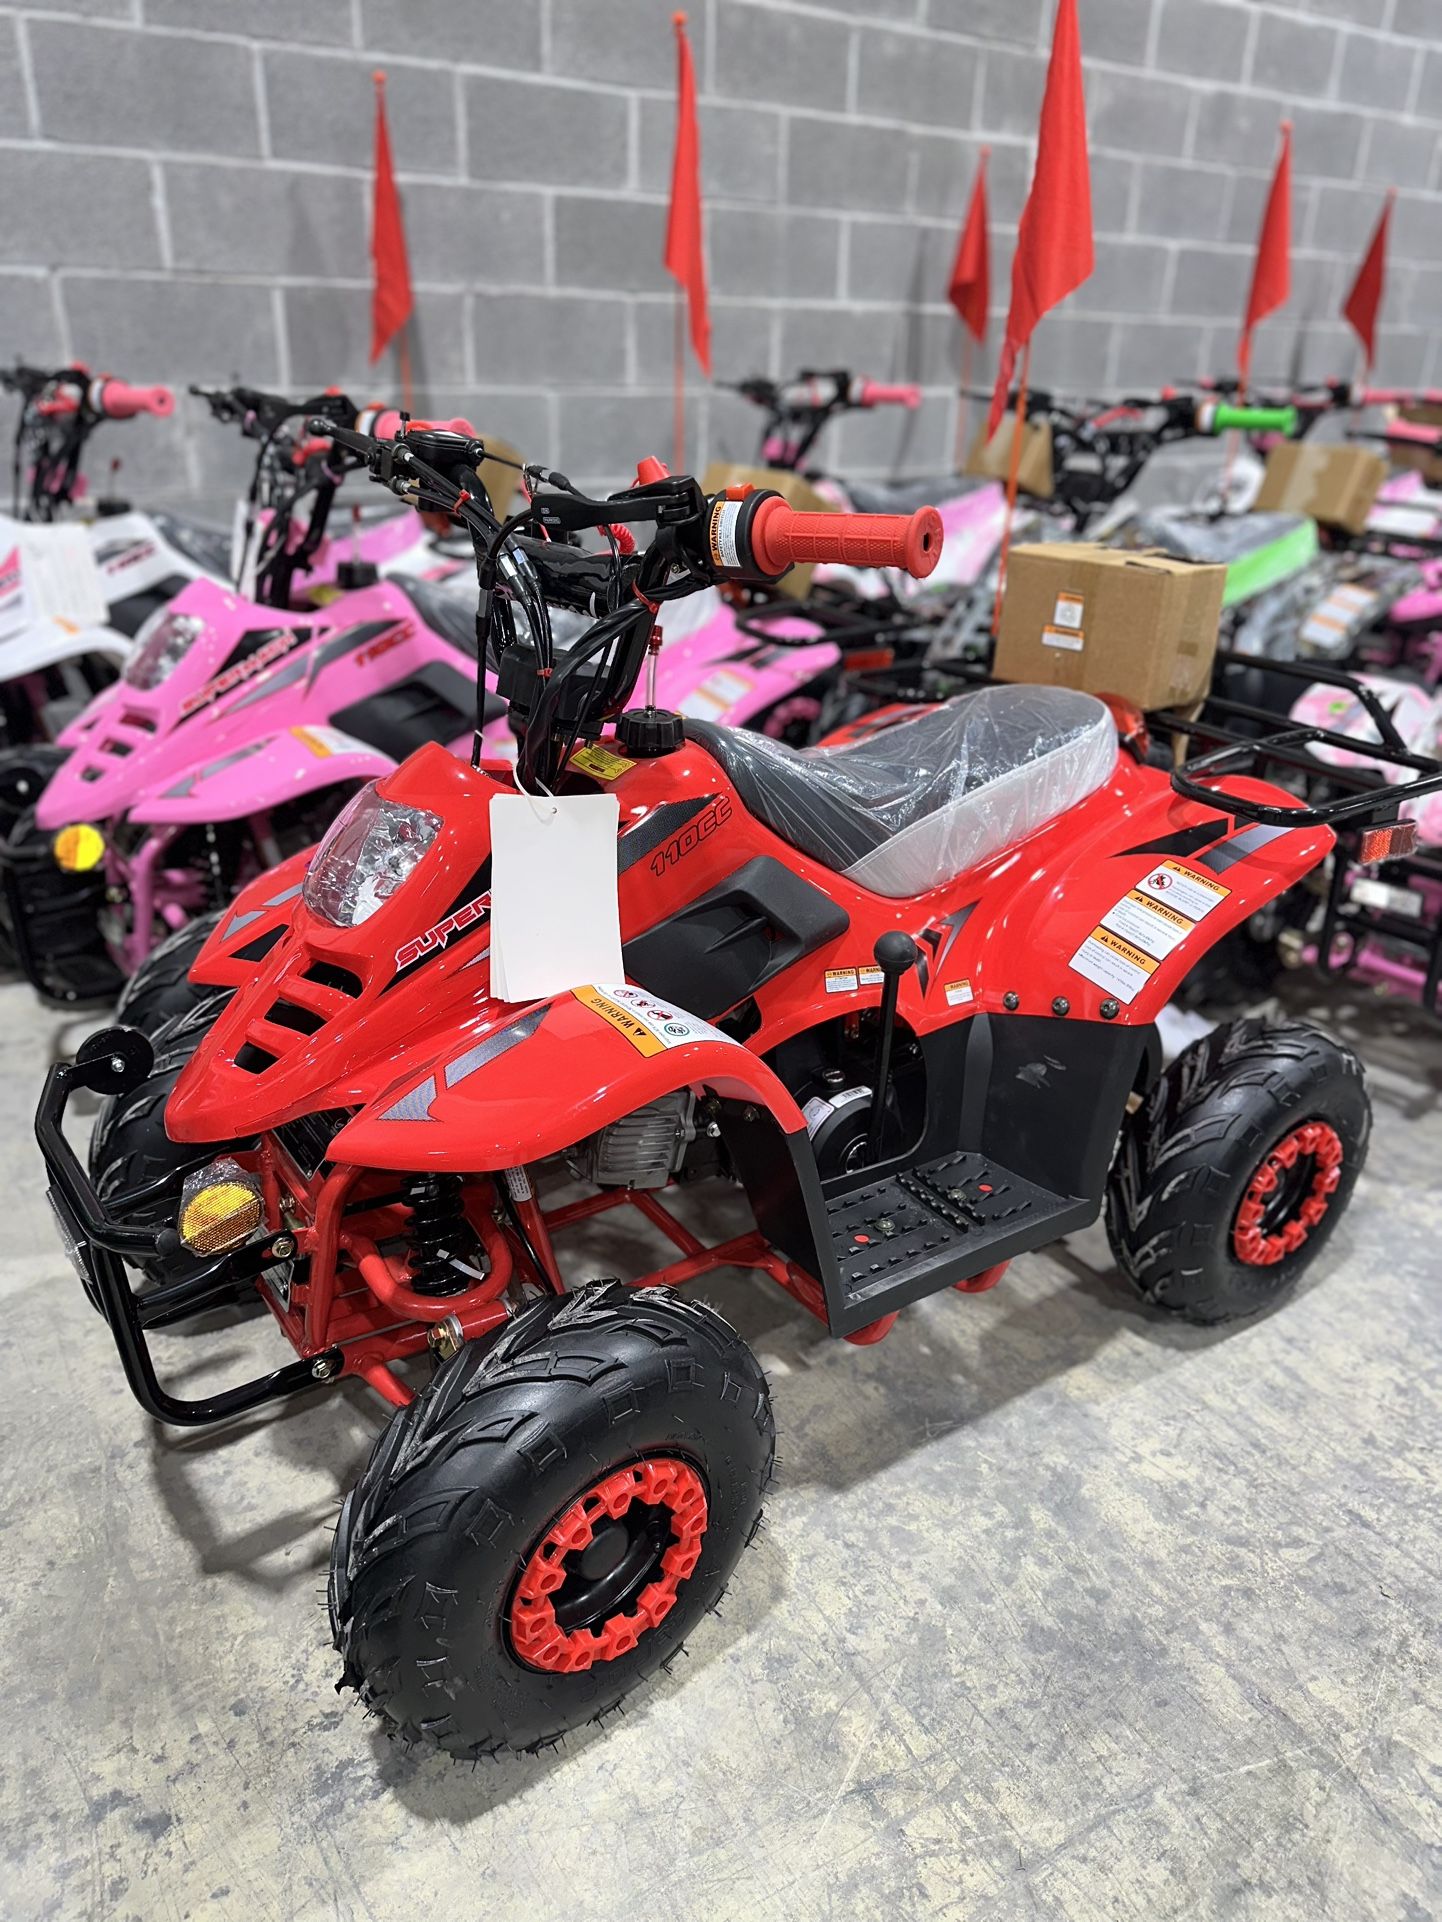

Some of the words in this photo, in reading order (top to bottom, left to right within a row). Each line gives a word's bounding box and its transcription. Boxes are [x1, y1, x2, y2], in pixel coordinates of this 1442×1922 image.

[711, 506, 722, 551] WARNING
[650, 796, 733, 877] 110CC
[1184, 870, 1220, 891] WARNING
[1146, 900, 1184, 925] WARNING
[395, 889, 492, 973] SUPER
[1110, 939, 1146, 965] WARNING
[590, 998, 635, 1029] WARNING
